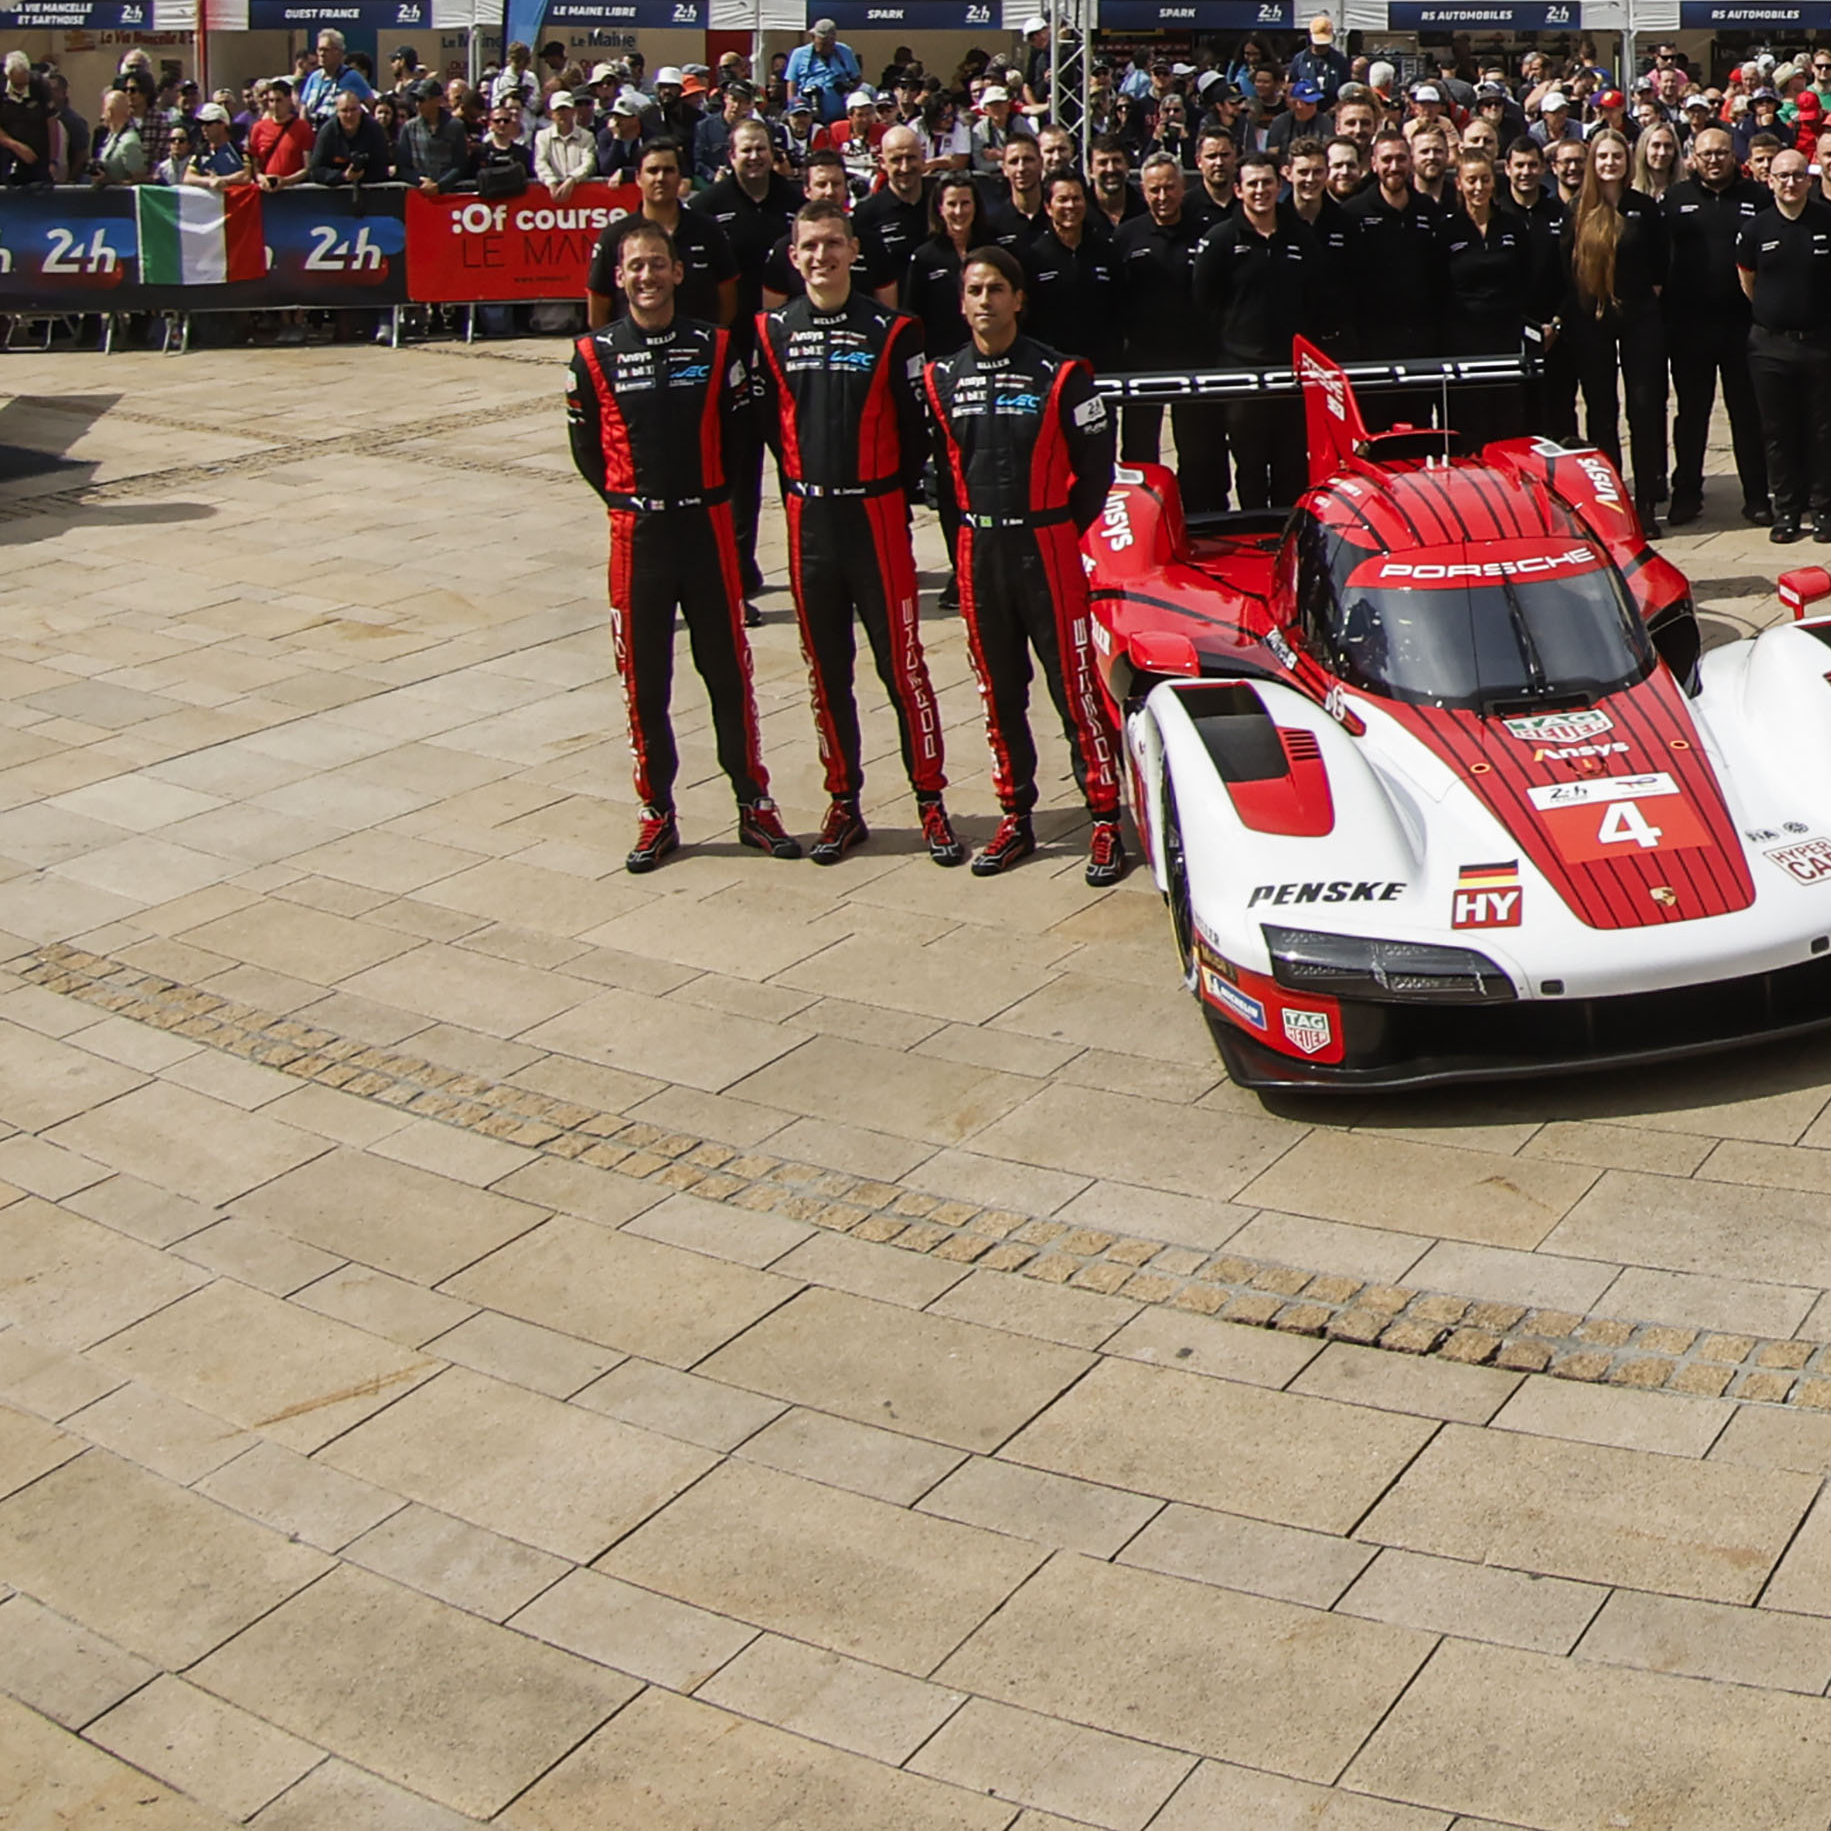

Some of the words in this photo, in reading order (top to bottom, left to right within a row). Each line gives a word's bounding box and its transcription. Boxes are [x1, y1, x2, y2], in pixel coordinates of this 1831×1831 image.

[25, 3, 41, 13] VIE
[41, 3, 93, 13] MANCELLE
[285, 8, 317, 19] OUEST
[319, 8, 360, 19] FRANCE
[553, 5, 566, 16] LE
[568, 6, 604, 16] MAINE
[605, 6, 636, 17] LIBRE
[867, 9, 904, 19] SPARK
[1159, 8, 1196, 18] SPARK
[1421, 10, 1436, 20] RS
[1437, 10, 1512, 21] AUTOMOBILES
[1712, 10, 1726, 20] RS
[1728, 10, 1800, 20] AUTOMOBILES
[18, 15, 30, 25] ET
[31, 15, 85, 25] SARTHOISE
[516, 207, 628, 232] course
[462, 235, 505, 268] LE
[524, 234, 596, 265] MAN
[791, 331, 824, 342] Ansys
[617, 351, 651, 364] Ansys
[957, 376, 987, 388] Ansys
[1577, 457, 1624, 514] Ansys
[1101, 491, 1133, 551] Ansys
[1380, 547, 1595, 578] PORSCHE
[1509, 711, 1600, 730] TAG
[1515, 721, 1609, 739] HEUER
[1534, 742, 1630, 762] Ansys
[1598, 801, 1663, 848] 4
[1247, 881, 1407, 908] PENSKE
[1455, 891, 1519, 923] HY
[1286, 1012, 1326, 1028] TAG
[1286, 1028, 1328, 1050] HEUER
